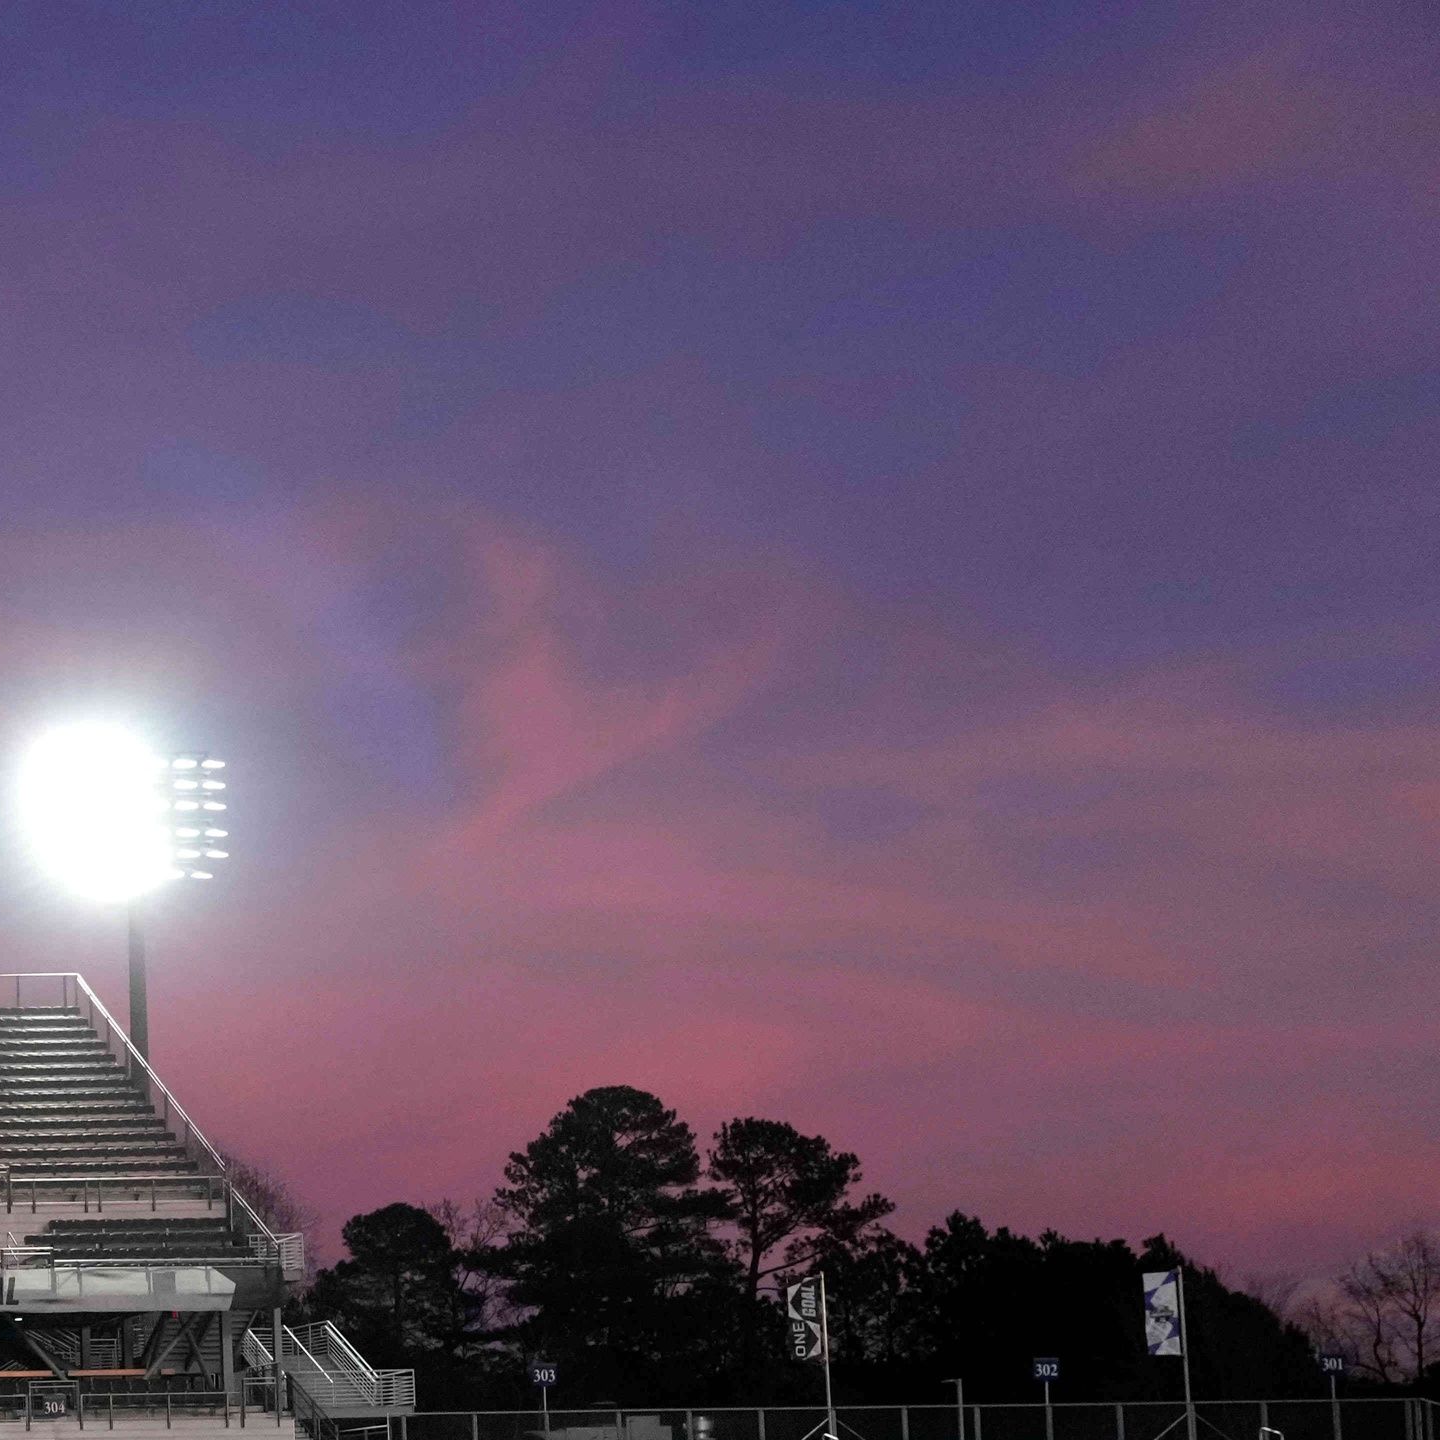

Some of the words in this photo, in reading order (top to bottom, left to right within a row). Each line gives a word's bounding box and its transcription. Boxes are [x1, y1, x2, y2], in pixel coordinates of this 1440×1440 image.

[800, 1285, 817, 1317] GOAL
[792, 1322, 806, 1357] ONE
[1035, 1363, 1058, 1377] 302
[1322, 1357, 1343, 1371] 301
[533, 1369, 556, 1383] 303
[44, 1400, 65, 1414] 304
